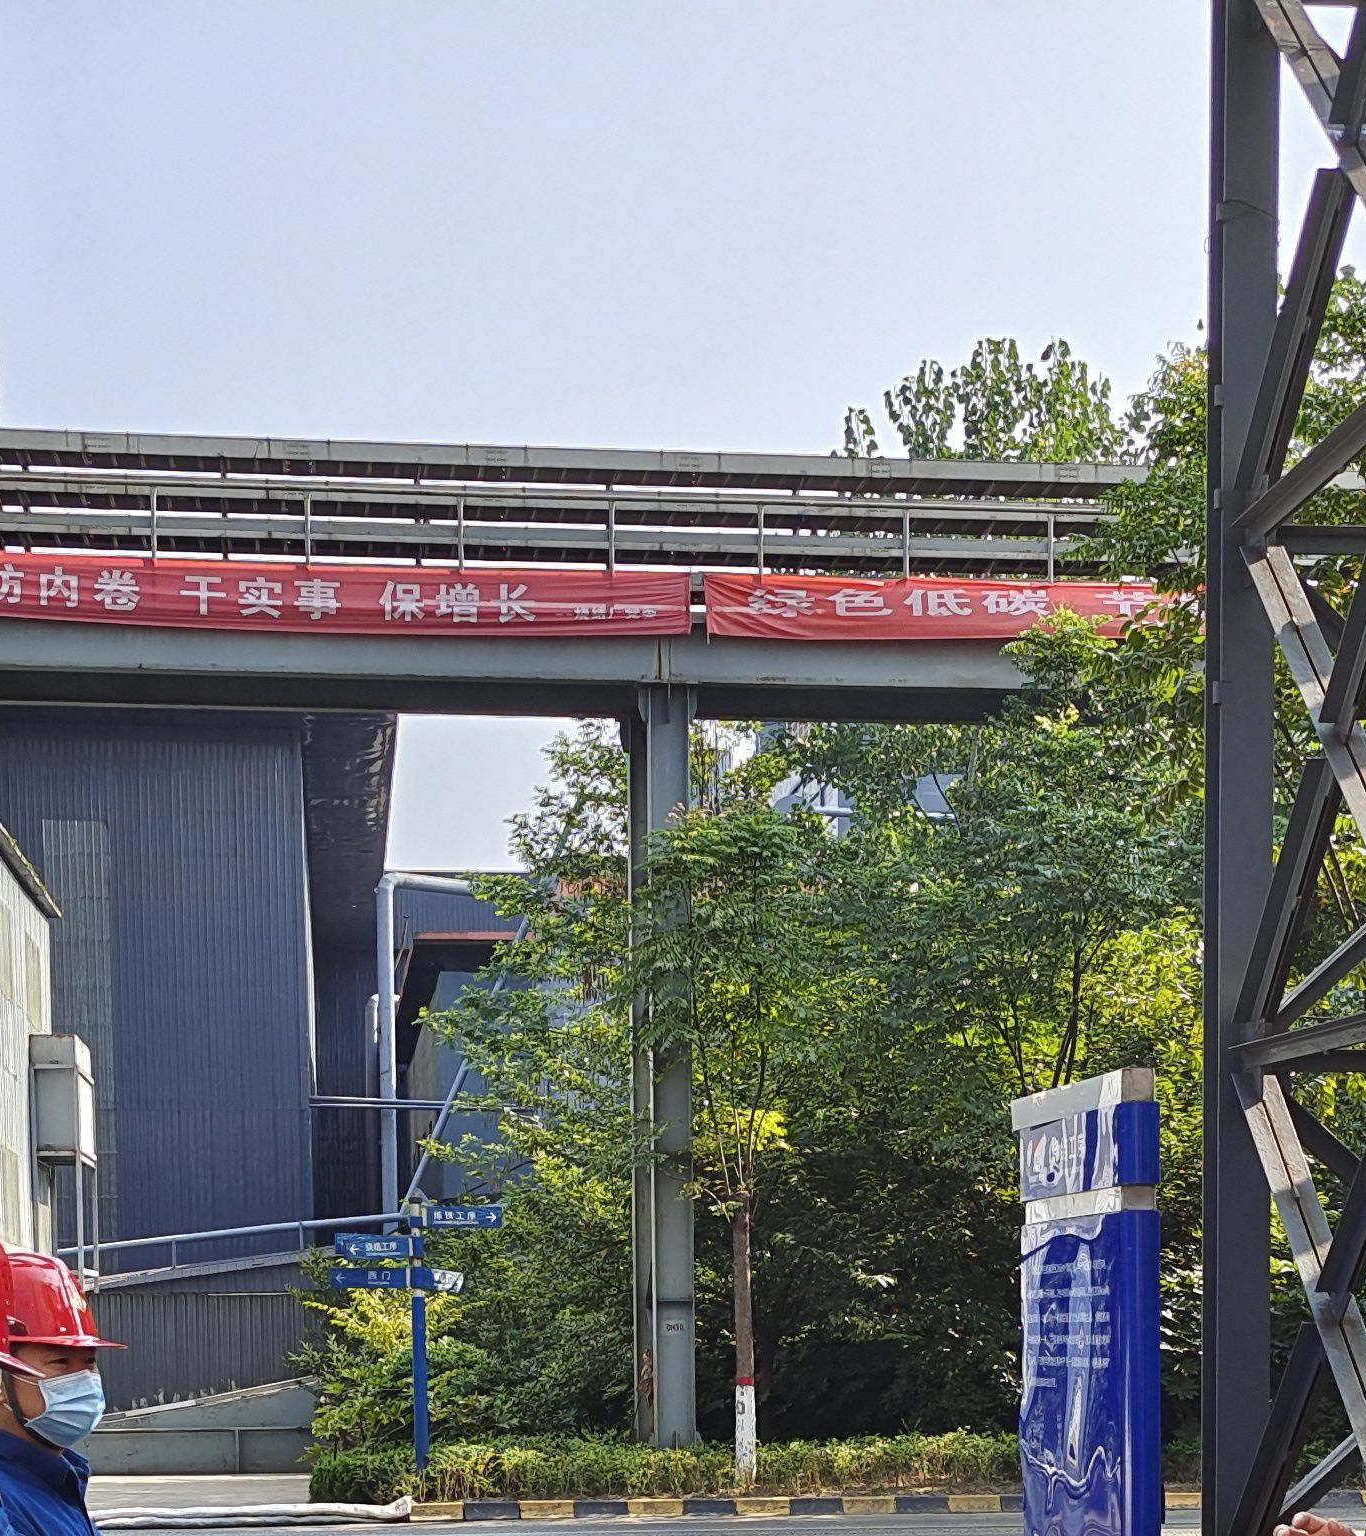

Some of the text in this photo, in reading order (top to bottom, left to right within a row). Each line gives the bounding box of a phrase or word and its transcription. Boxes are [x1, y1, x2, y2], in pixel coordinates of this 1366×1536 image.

[180, 574, 341, 621] 干实事
[379, 579, 537, 623] 保增长
[747, 588, 1051, 618] 绿色低碳
